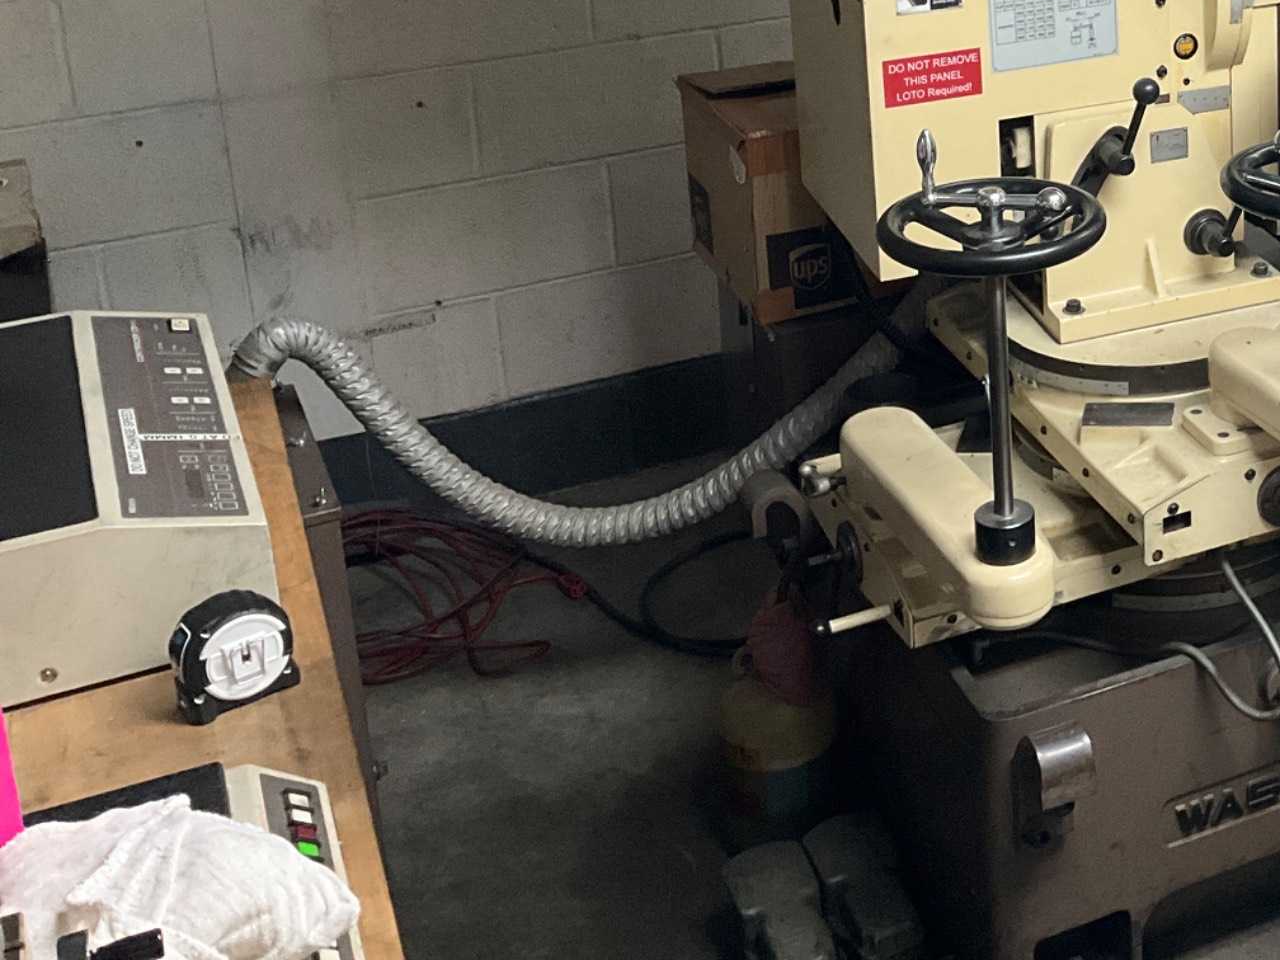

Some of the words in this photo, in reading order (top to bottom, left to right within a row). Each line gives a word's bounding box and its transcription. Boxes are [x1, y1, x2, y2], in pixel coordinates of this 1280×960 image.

[888, 63, 905, 75] DO
[907, 59, 930, 72] NOT
[932, 52, 978, 69] REMOVE
[903, 74, 928, 88] THIS
[930, 69, 964, 83] PANEL
[896, 88, 926, 103] LOTO
[927, 82, 973, 98] Required!
[794, 256, 828, 282] ups
